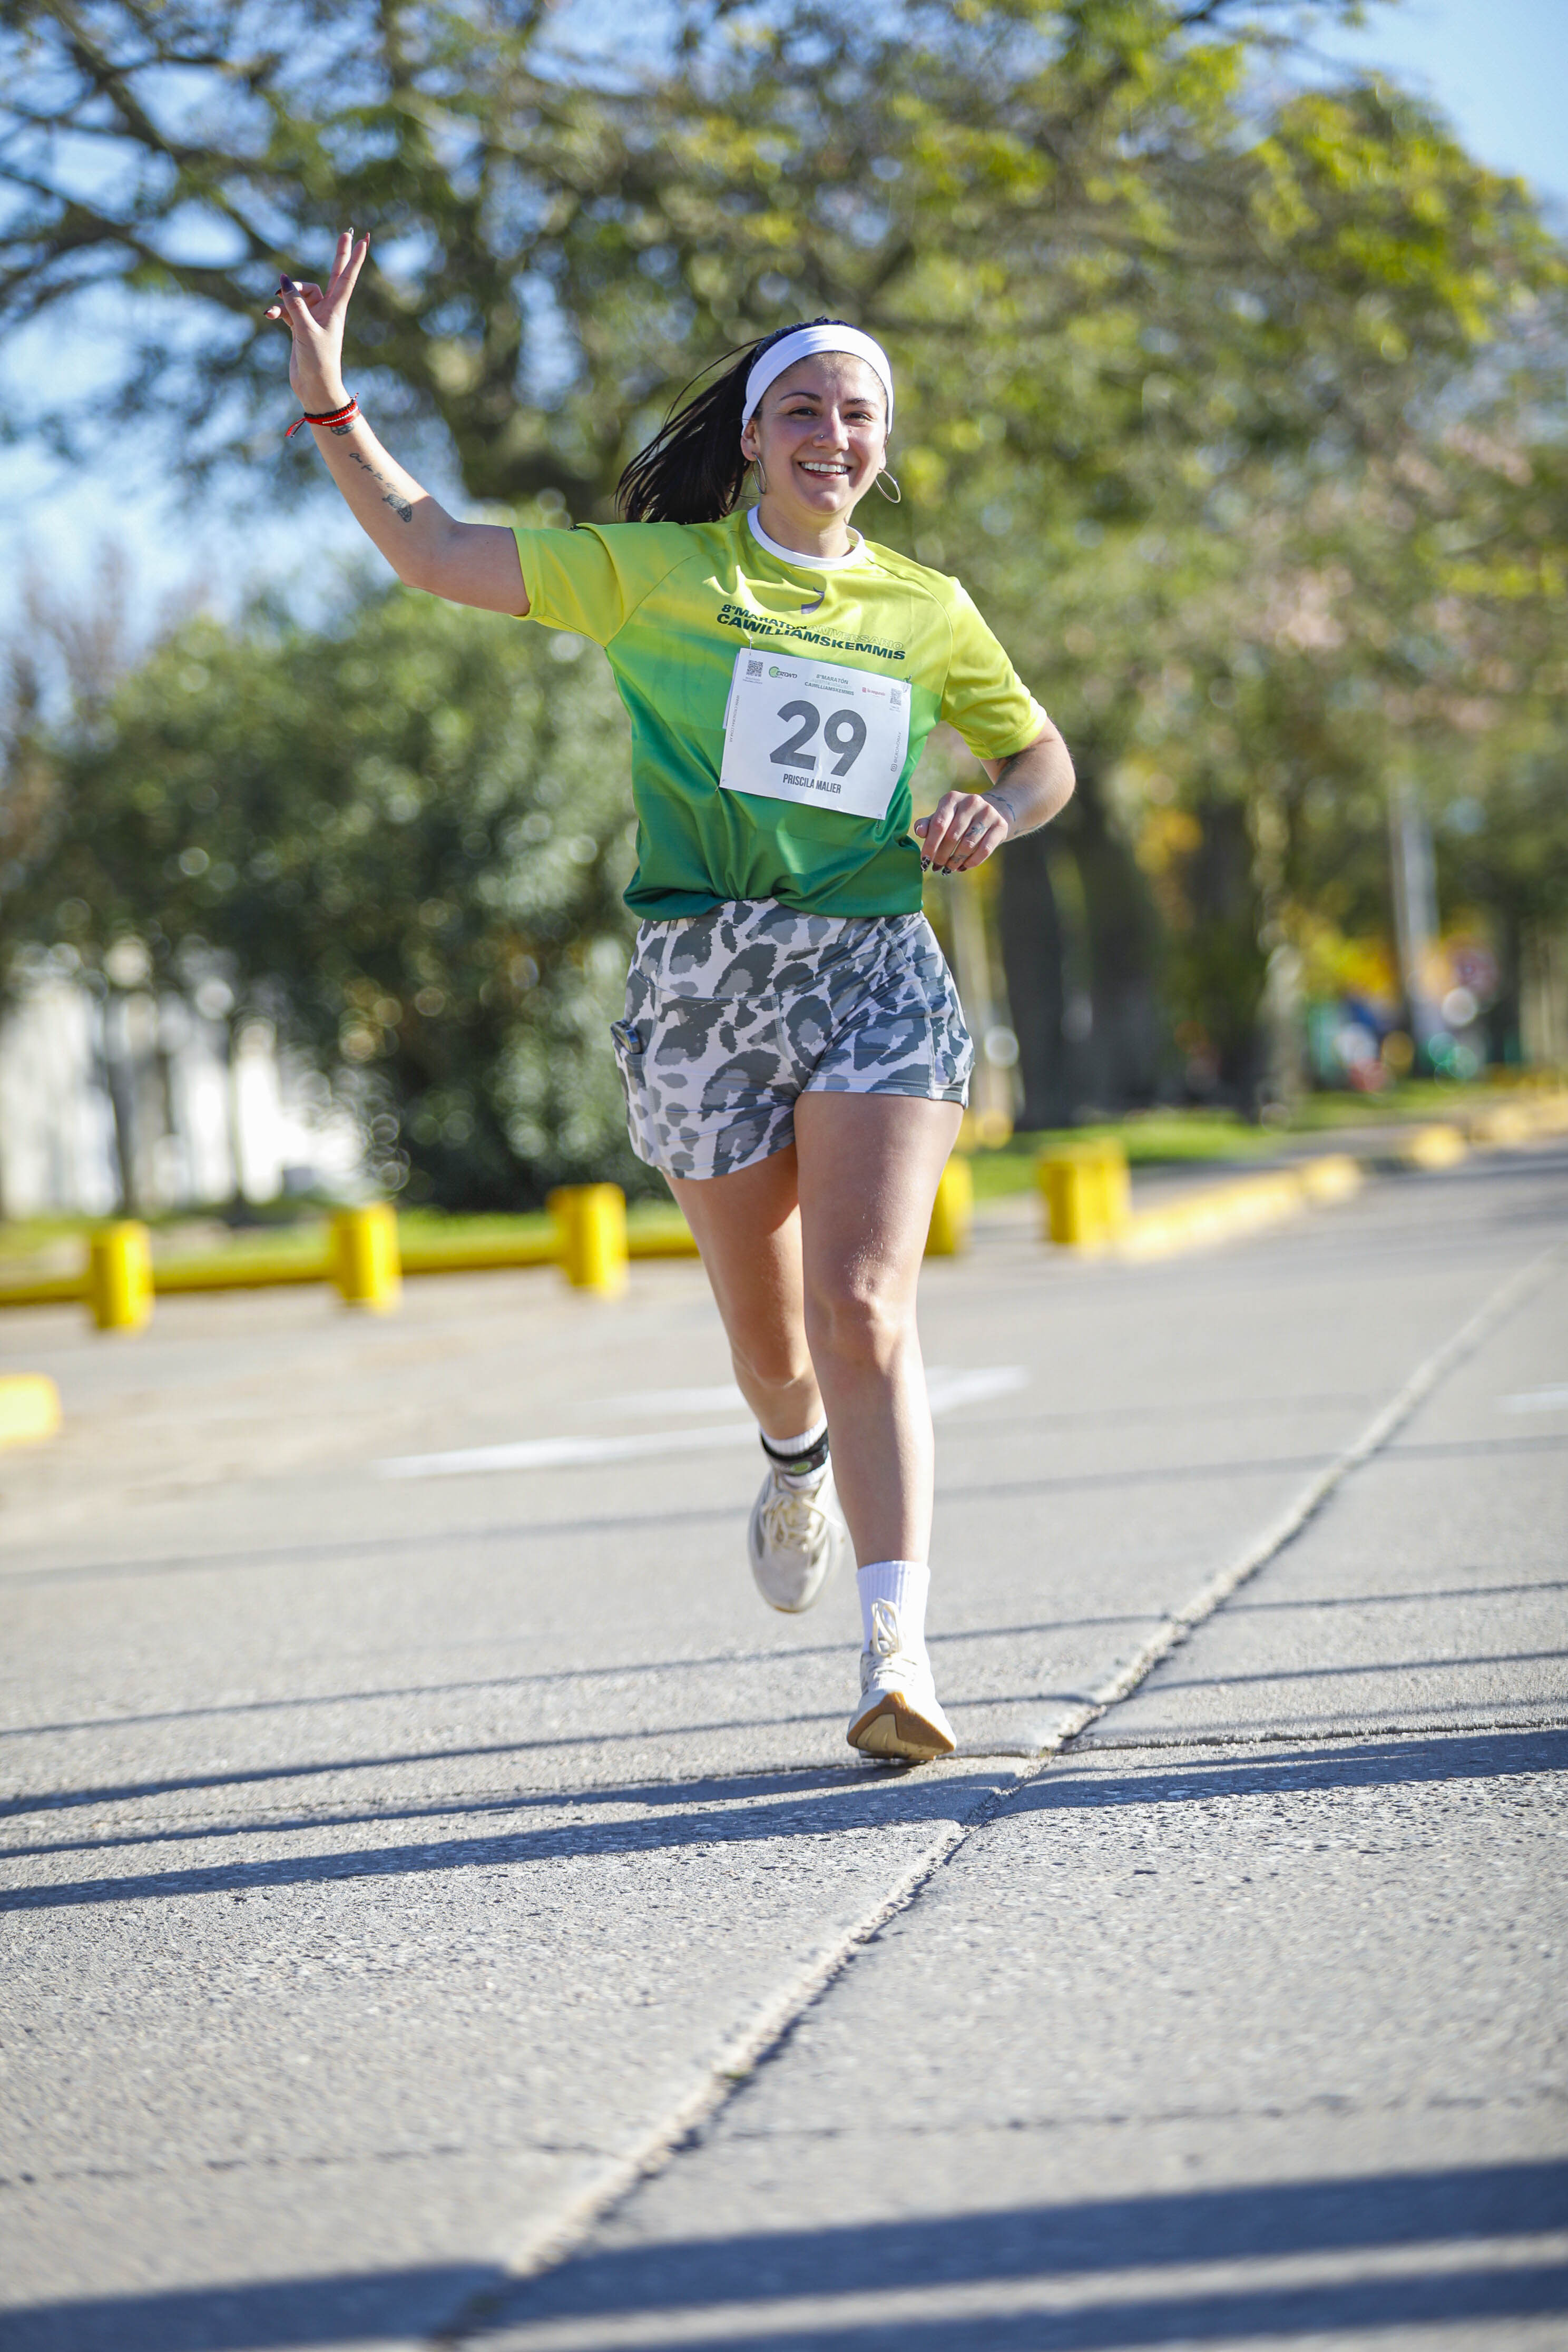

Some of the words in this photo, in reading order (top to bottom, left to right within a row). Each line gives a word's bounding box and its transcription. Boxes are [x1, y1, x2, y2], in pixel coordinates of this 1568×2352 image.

[717, 614, 906, 660] CAWILLIAMSKEMMIS
[807, 625, 904, 650] ANIVERSARIO
[770, 700, 867, 777] 29
[783, 773, 814, 789] PRISCILA
[817, 780, 841, 793] MALIER
